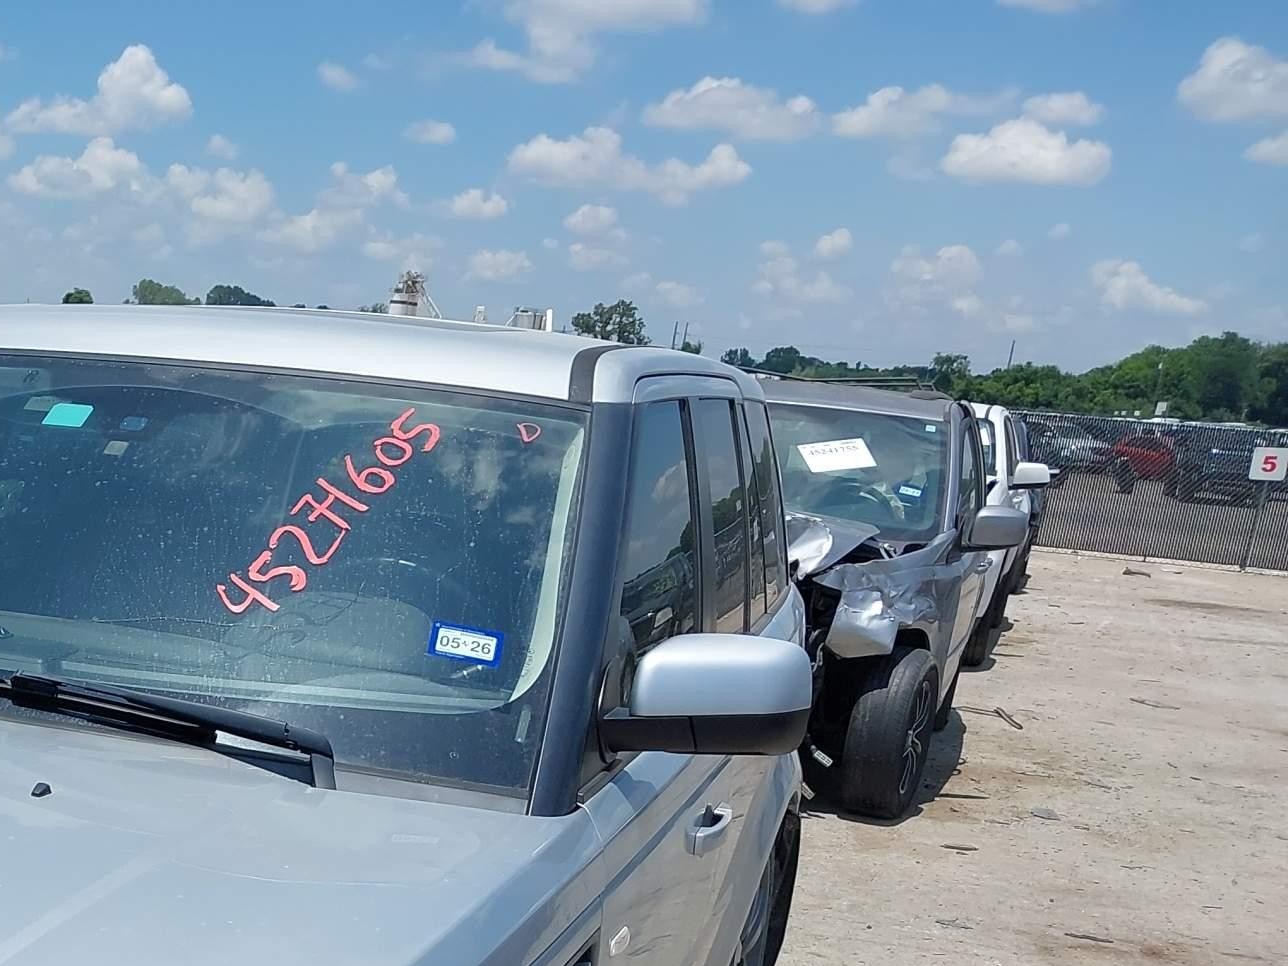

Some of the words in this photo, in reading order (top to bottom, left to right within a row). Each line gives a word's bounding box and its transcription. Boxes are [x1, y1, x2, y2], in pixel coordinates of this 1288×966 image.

[1261, 455, 1278, 473] 5
[216, 408, 441, 613] 45271605
[439, 634, 461, 650] 05
[469, 639, 492, 656] 26
